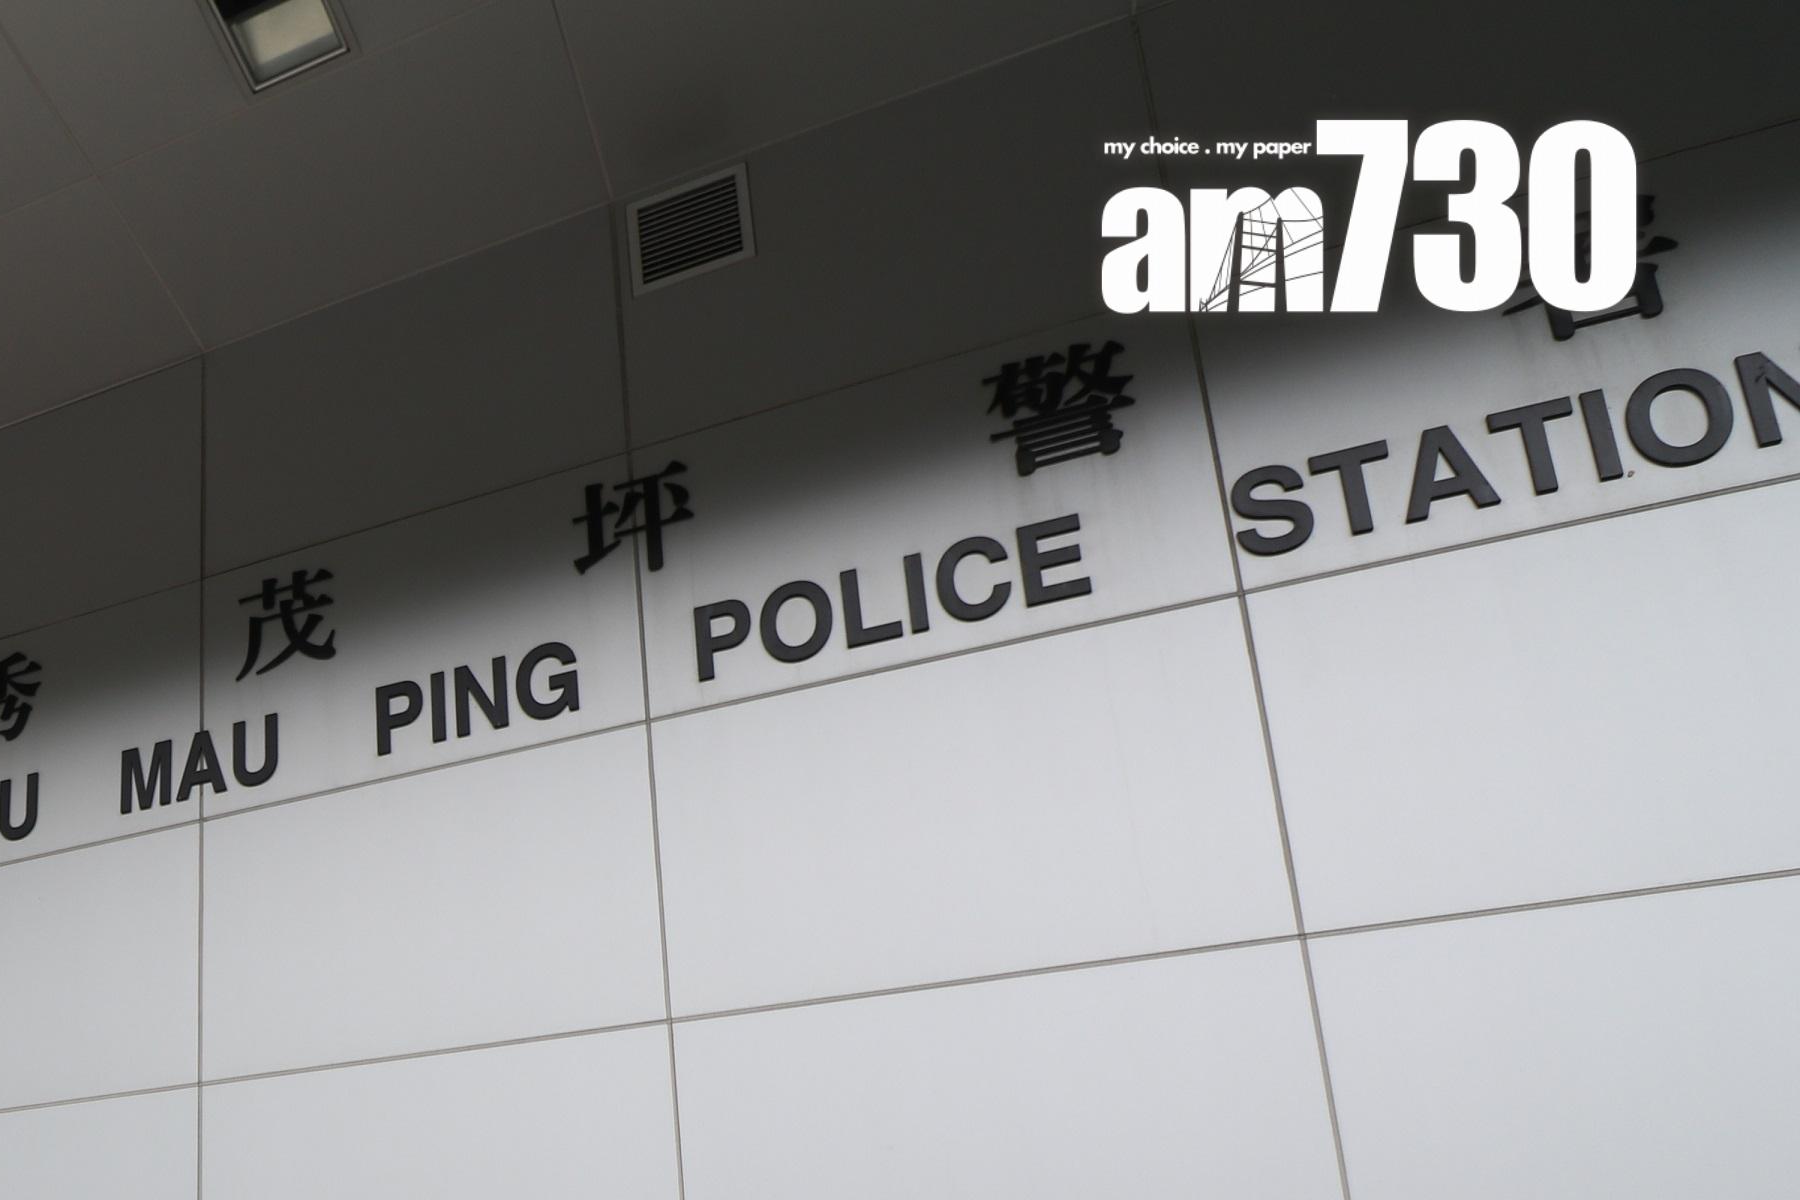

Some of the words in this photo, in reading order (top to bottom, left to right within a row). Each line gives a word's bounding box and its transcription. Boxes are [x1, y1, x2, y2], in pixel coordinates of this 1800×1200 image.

[119, 713, 279, 814] MAU
[374, 641, 582, 756] PING
[693, 513, 1093, 683] POLICE
[1231, 351, 1800, 556] STATION
